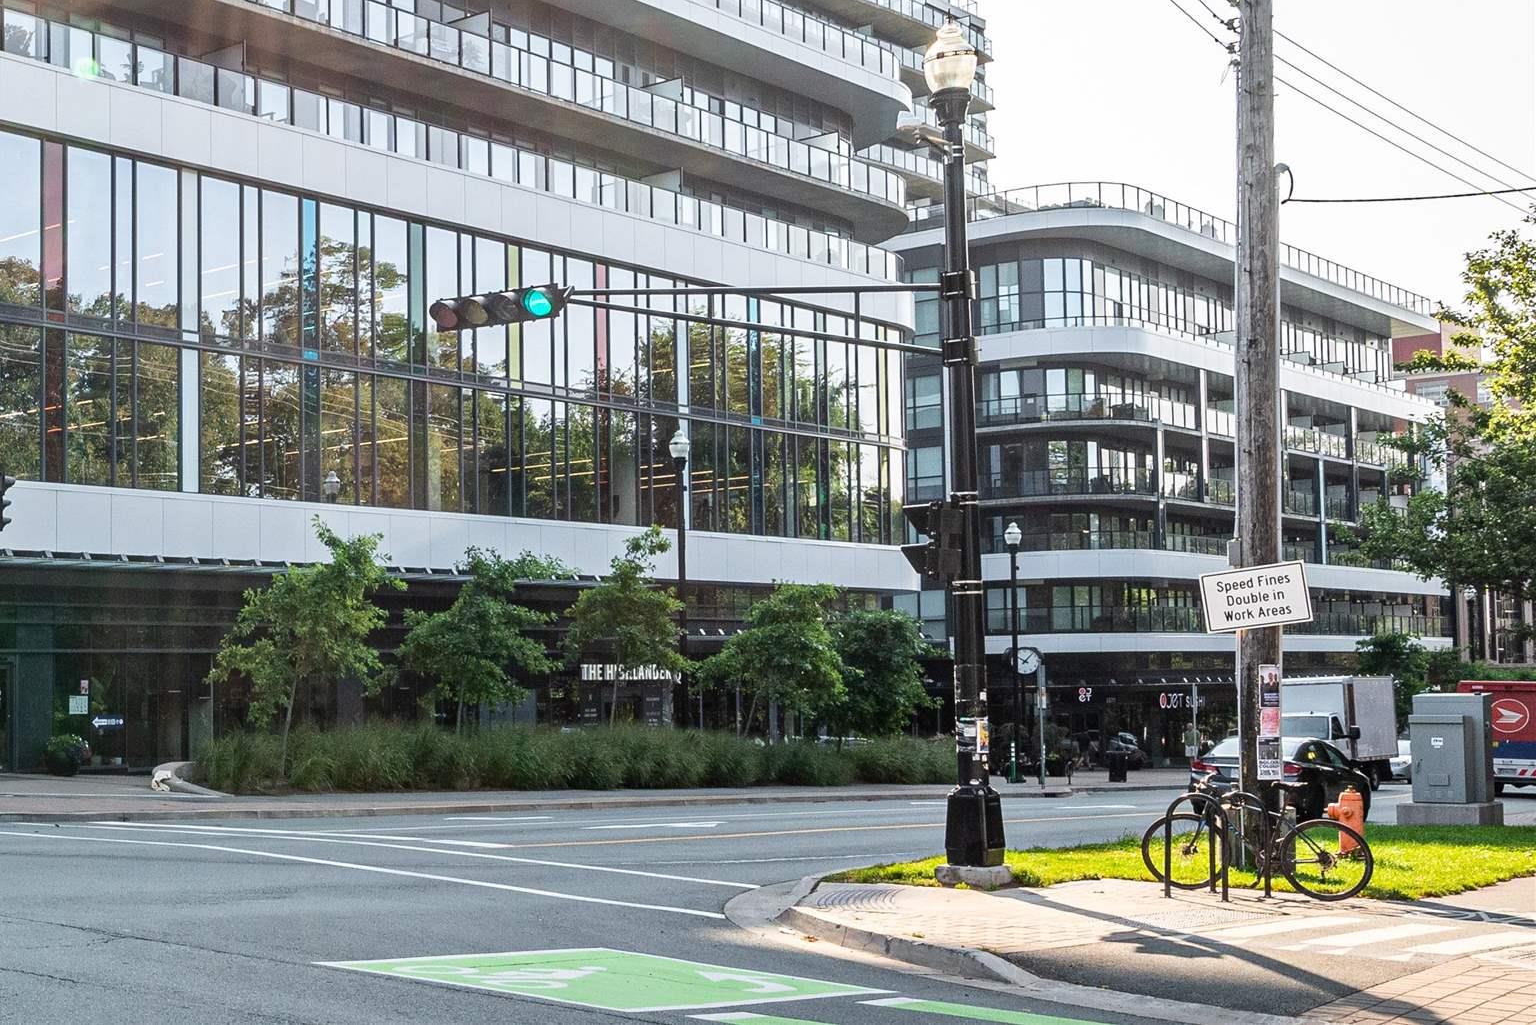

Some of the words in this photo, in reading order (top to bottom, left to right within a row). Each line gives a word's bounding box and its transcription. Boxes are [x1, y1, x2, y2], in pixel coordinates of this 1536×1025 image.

[1216, 577, 1254, 594] Speed
[1257, 574, 1291, 587] Fines
[1226, 592, 1270, 607] Double
[1272, 589, 1285, 600] in
[1224, 608, 1255, 622] Work
[1258, 605, 1292, 618] Areas
[580, 663, 603, 681] THE
